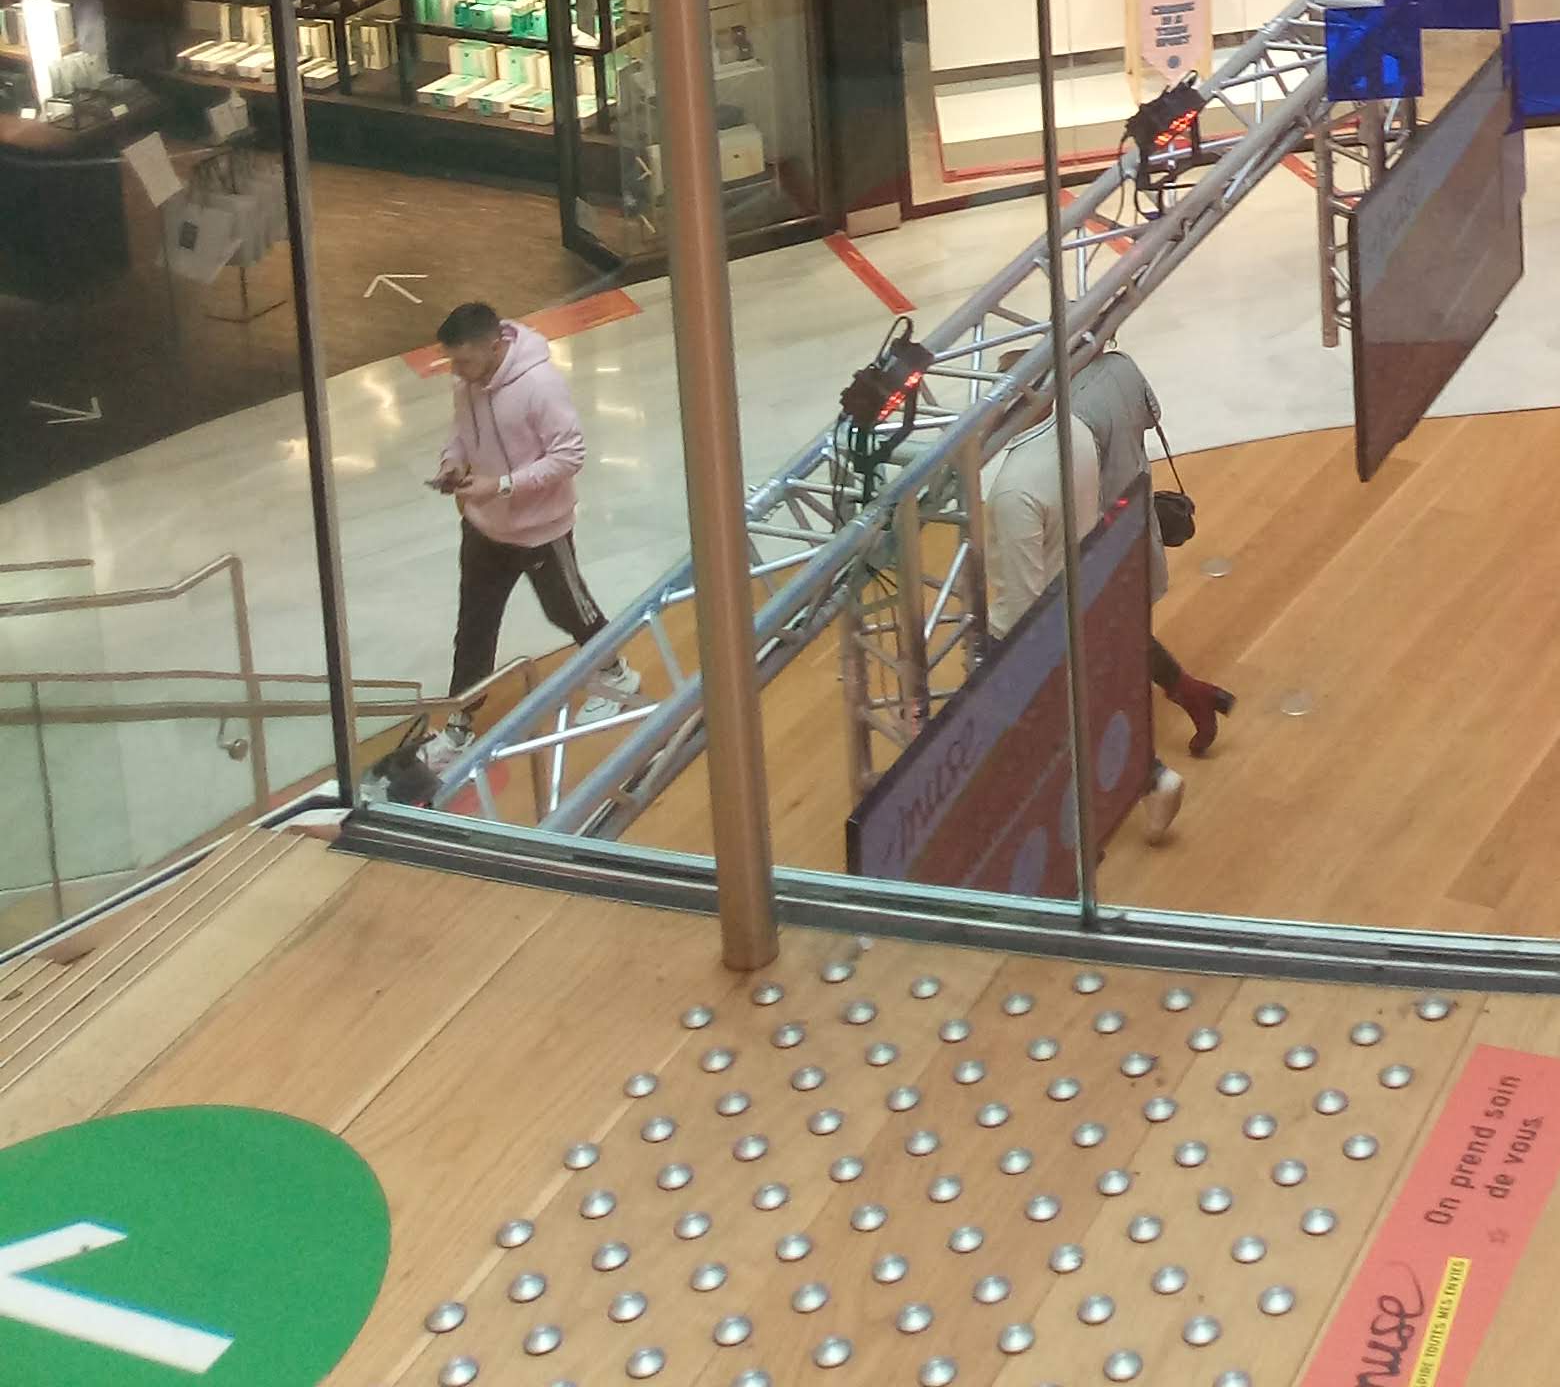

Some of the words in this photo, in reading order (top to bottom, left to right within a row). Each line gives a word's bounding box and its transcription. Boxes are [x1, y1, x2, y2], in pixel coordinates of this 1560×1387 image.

[1424, 1196, 1461, 1225] On
[1450, 1125, 1496, 1189] prend
[1484, 1075, 1521, 1120] soin
[1484, 1174, 1515, 1199] de
